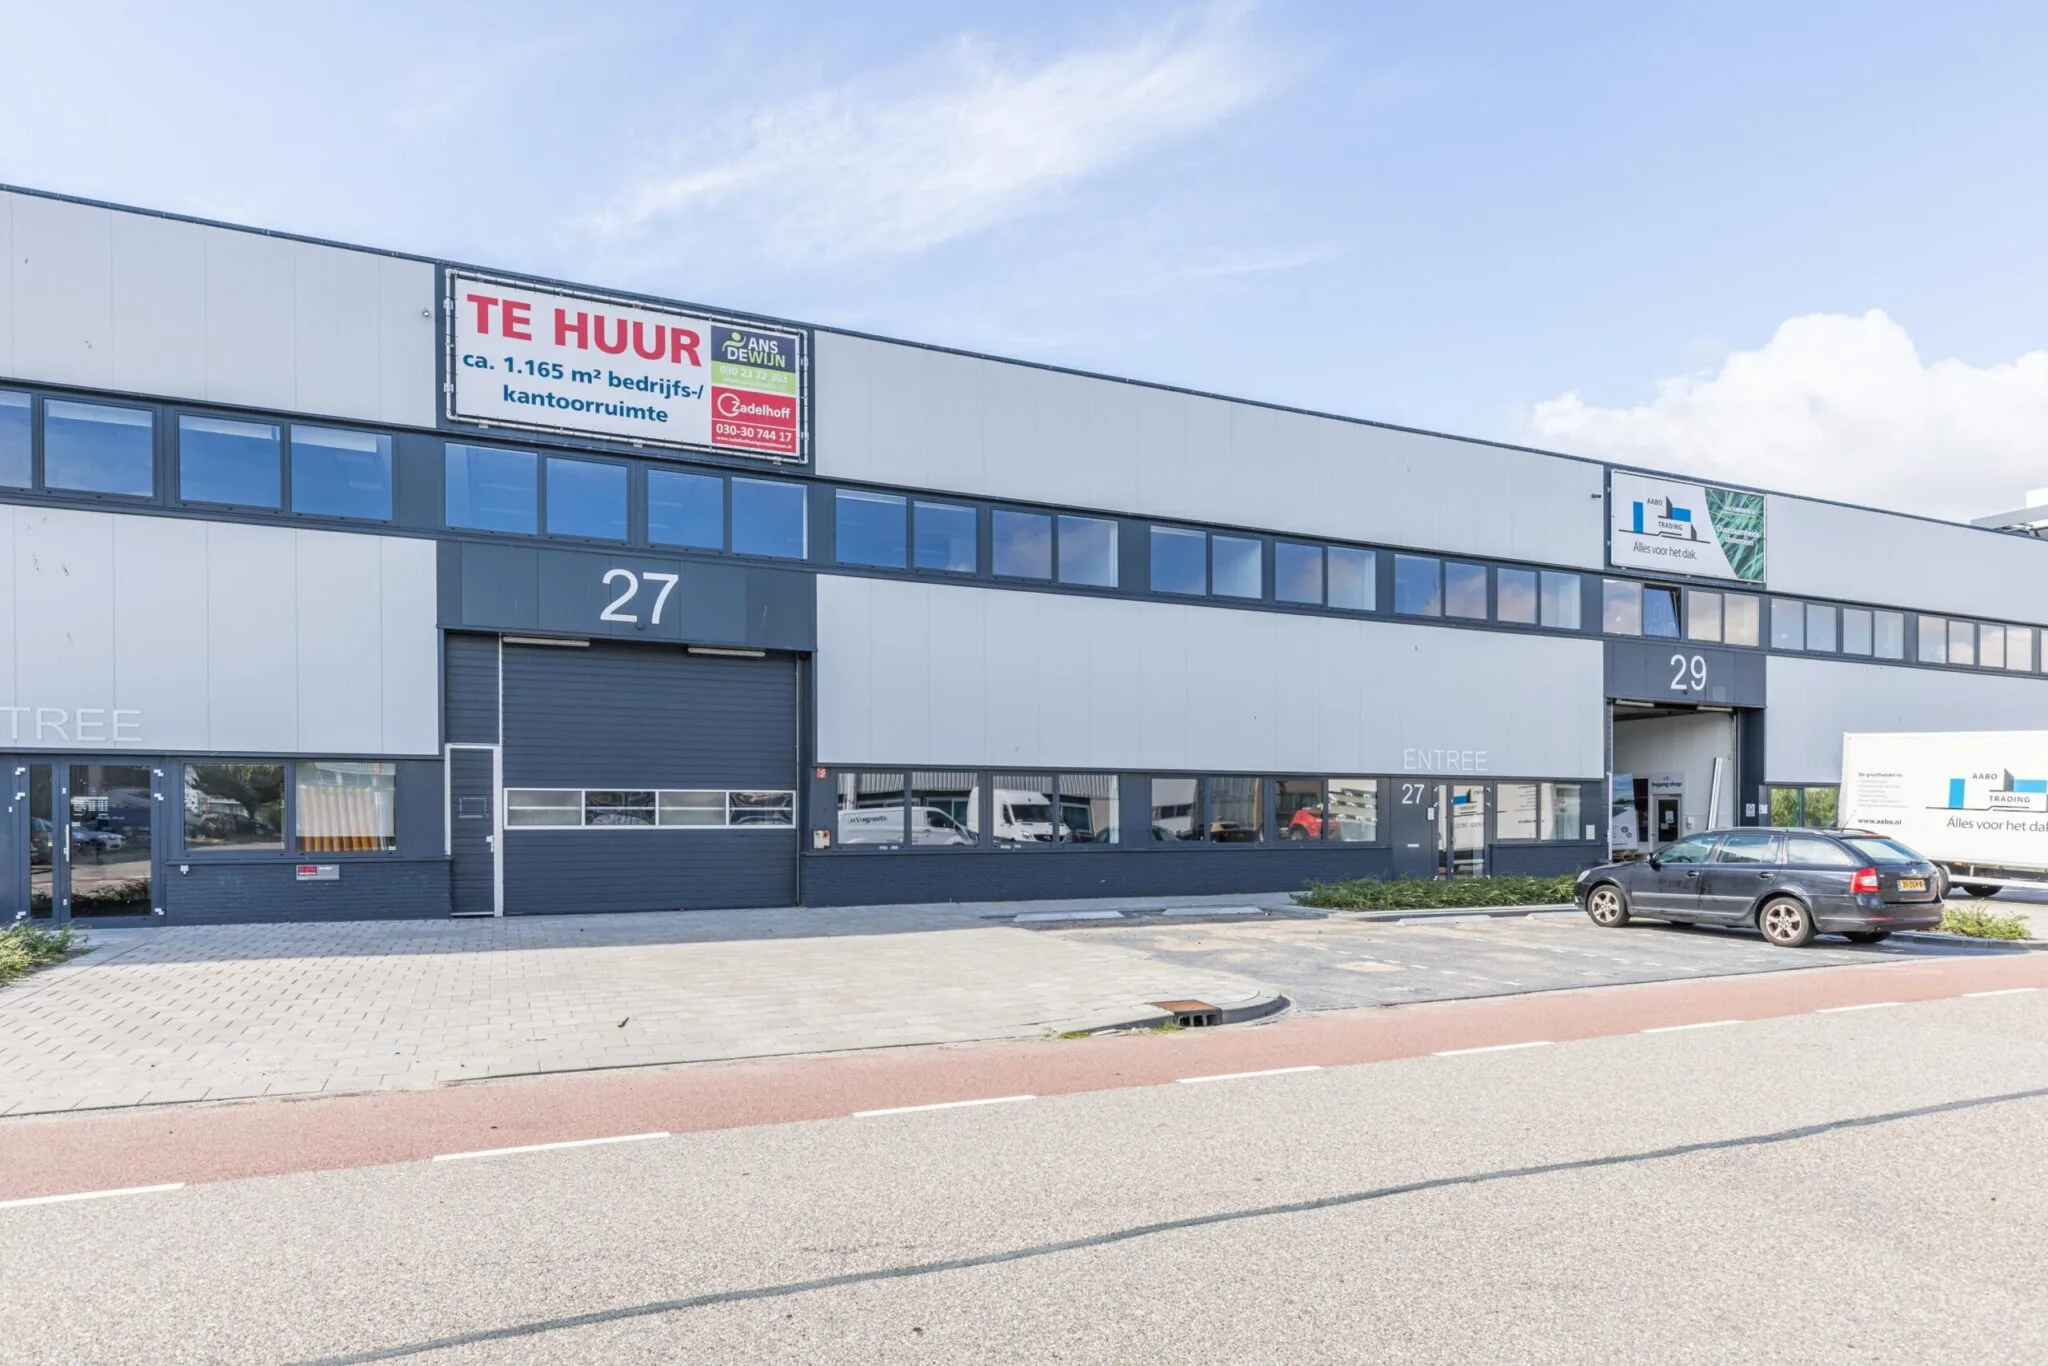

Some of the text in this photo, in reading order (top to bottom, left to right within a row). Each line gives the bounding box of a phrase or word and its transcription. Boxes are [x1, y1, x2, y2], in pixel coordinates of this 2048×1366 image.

[467, 294, 702, 367] TE HUUR
[748, 338, 778, 354] ANS
[463, 354, 494, 370] ca.
[504, 356, 563, 379] 1.165
[608, 371, 704, 400] bedrijfs-/
[503, 385, 669, 423] kantoorruimte
[732, 400, 791, 419] Zadelhoff
[716, 423, 792, 442] 030-30 744 17
[1647, 498, 1663, 506] AABO
[1658, 521, 1683, 531] TRADING
[1652, 547, 1668, 556] voor
[1669, 546, 1681, 557] het
[1682, 549, 1698, 560] dak.
[600, 569, 679, 625] 27
[1670, 654, 1707, 690] 29
[0, 707, 142, 742] TREE
[1404, 748, 1489, 772] ENTREE
[1401, 783, 1425, 804] 27
[1989, 795, 2030, 803] TRADING
[1976, 821, 2004, 830] voor
[2006, 820, 2026, 831] het
